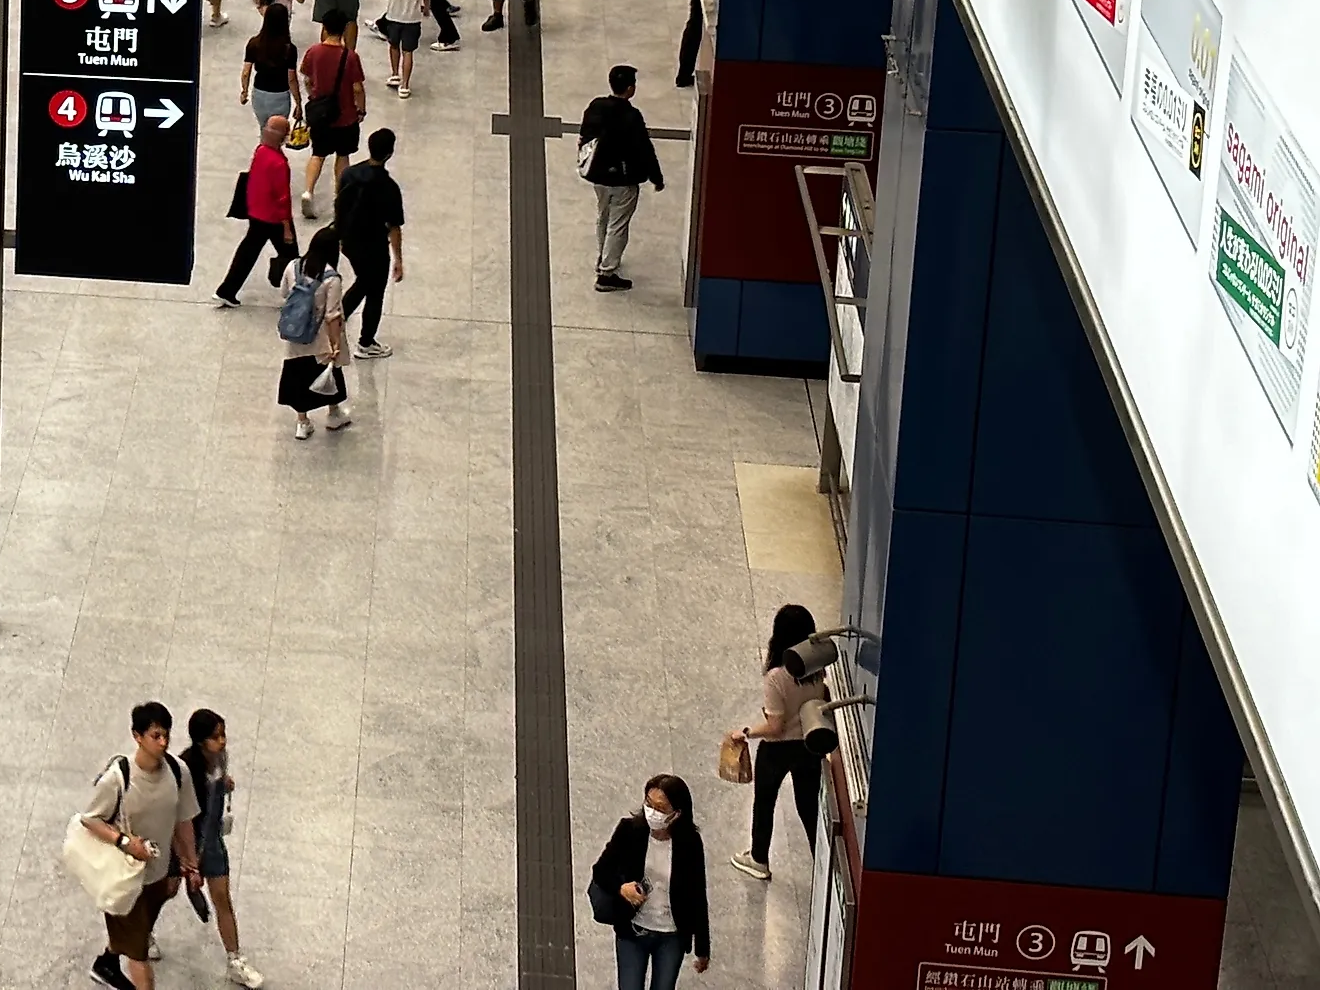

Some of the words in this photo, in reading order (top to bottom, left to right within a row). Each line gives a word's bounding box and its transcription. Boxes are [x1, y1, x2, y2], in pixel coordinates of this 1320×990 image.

[85, 26, 139, 53] 屯門
[77, 52, 108, 66] Tuen
[110, 54, 138, 67] Mun
[776, 90, 812, 108] 屯門
[823, 98, 835, 115] 3
[57, 96, 78, 121] 4
[770, 108, 791, 117] Tuen
[791, 110, 810, 119] Mun
[68, 169, 90, 182] Wu
[91, 170, 110, 183] Kai
[112, 171, 136, 184] Sha
[1226, 122, 1267, 209] sagami
[1266, 191, 1310, 286] original
[953, 920, 1001, 944] 屯門
[944, 943, 971, 956] Tuen
[973, 945, 999, 958] Mun
[1028, 932, 1043, 952] 3
